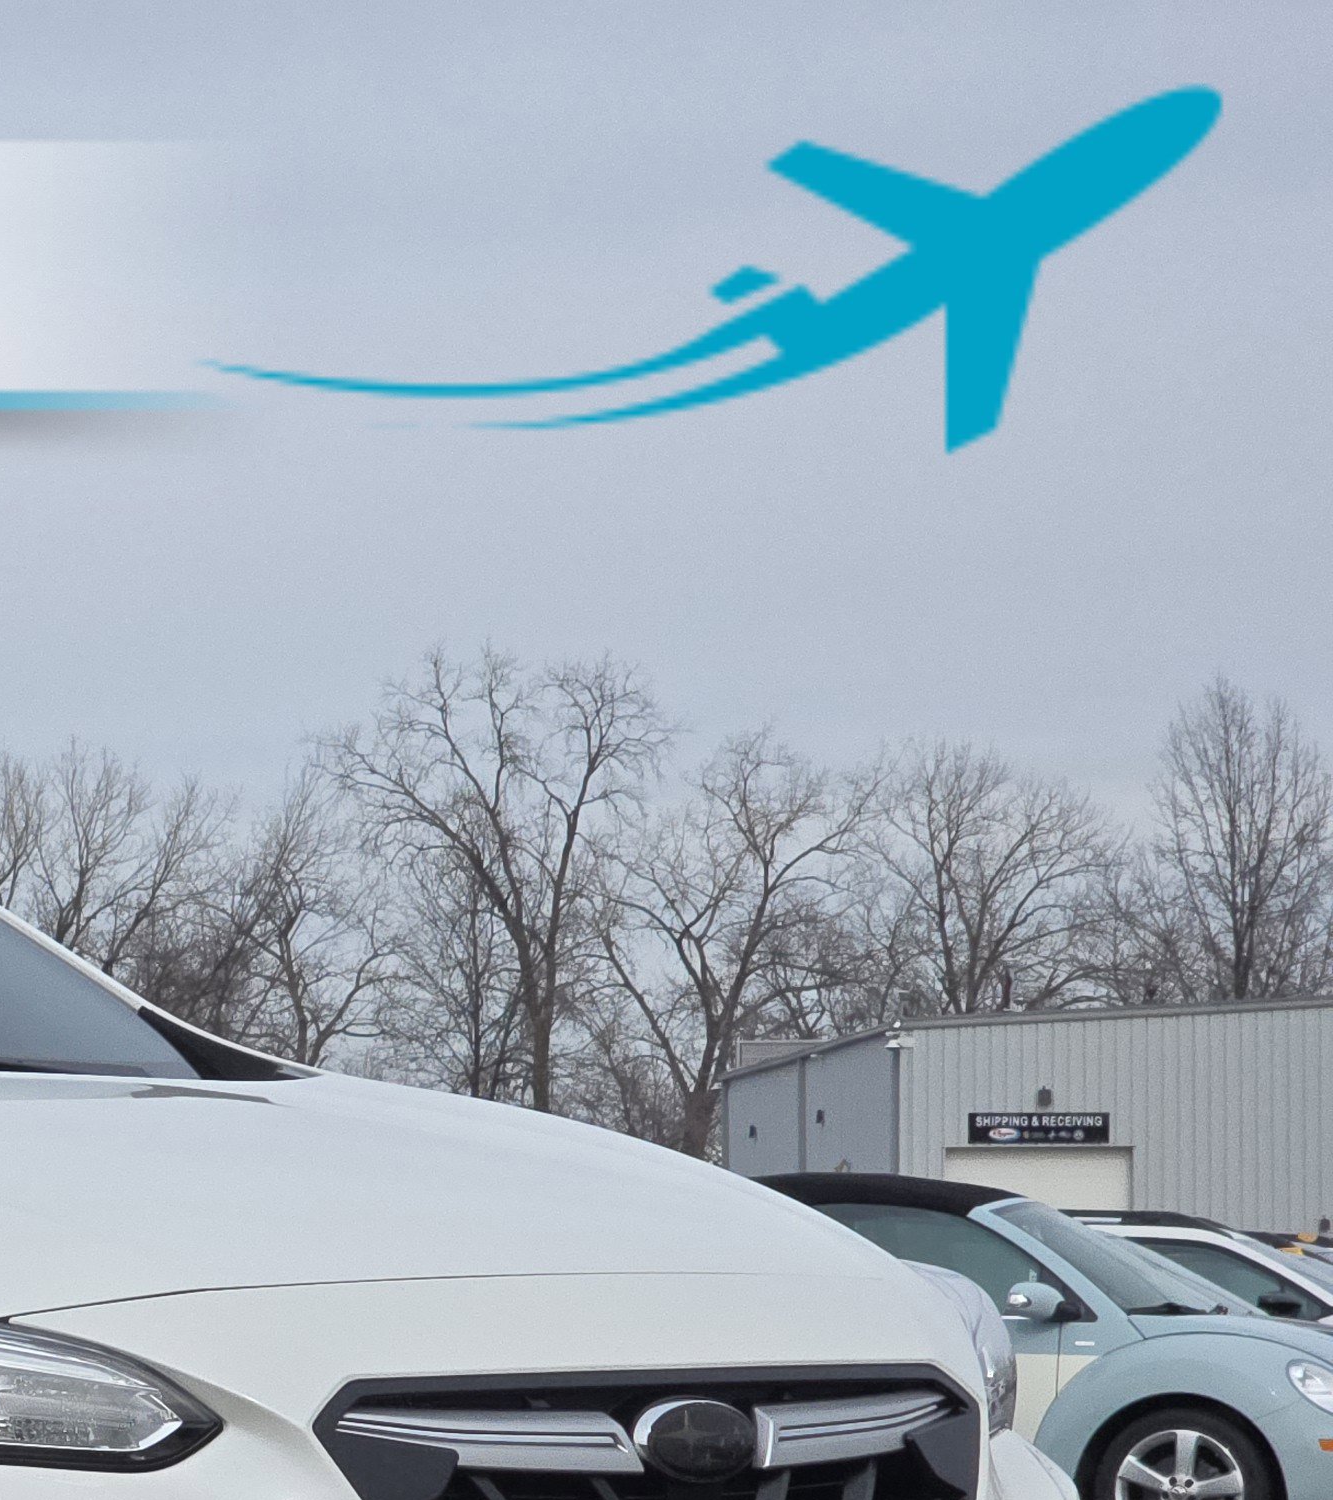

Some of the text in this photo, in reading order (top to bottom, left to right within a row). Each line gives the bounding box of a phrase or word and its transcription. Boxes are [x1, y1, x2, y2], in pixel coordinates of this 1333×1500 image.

[975, 1115, 1103, 1127] SHIPPING & RECEIVING
